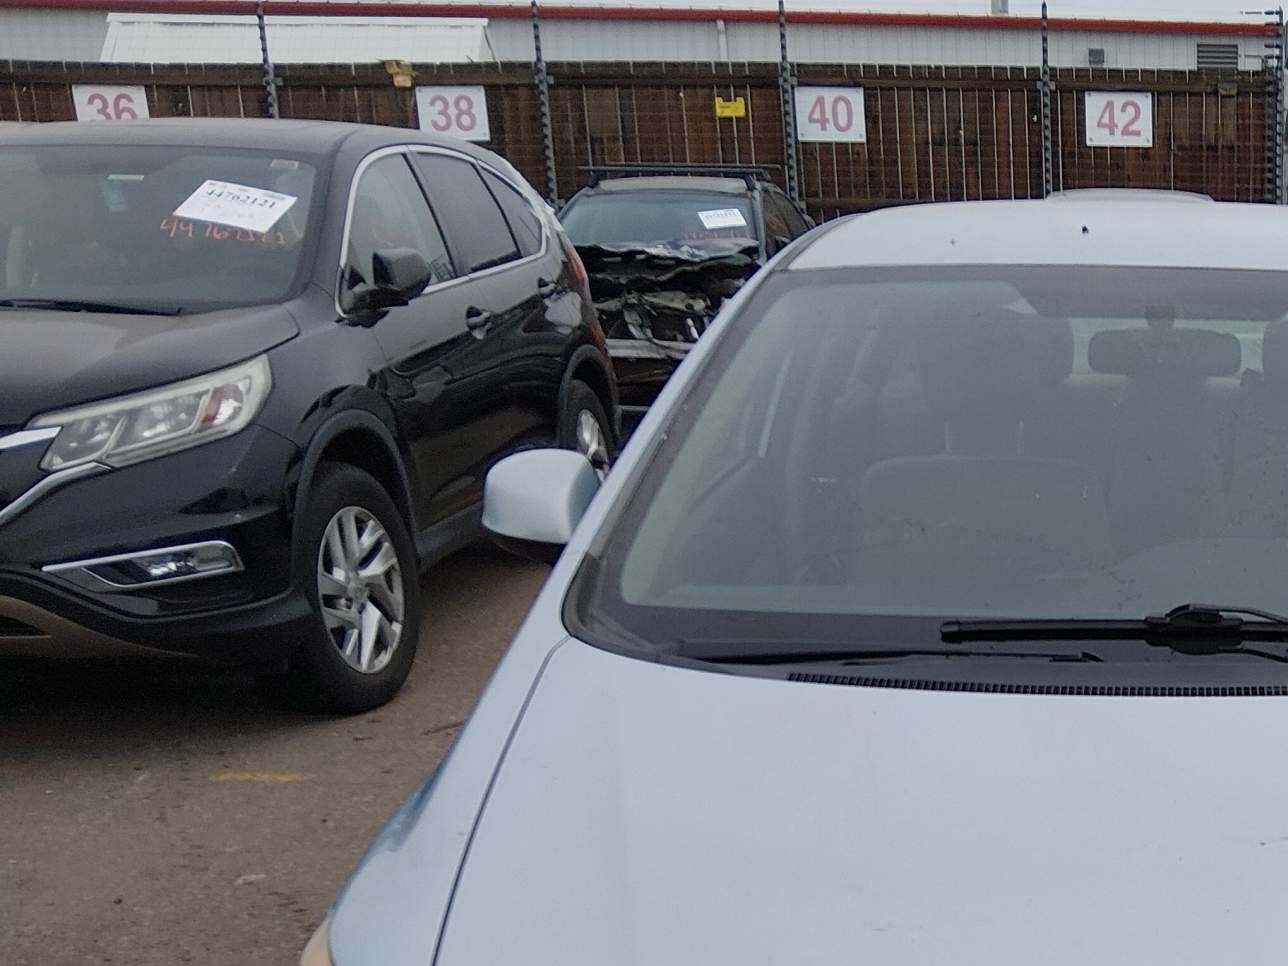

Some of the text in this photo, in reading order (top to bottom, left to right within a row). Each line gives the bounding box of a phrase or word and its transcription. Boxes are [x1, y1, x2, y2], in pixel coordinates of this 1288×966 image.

[87, 93, 139, 120] 36
[429, 94, 477, 132] 38
[807, 95, 853, 132] 40
[1097, 100, 1142, 136] 42
